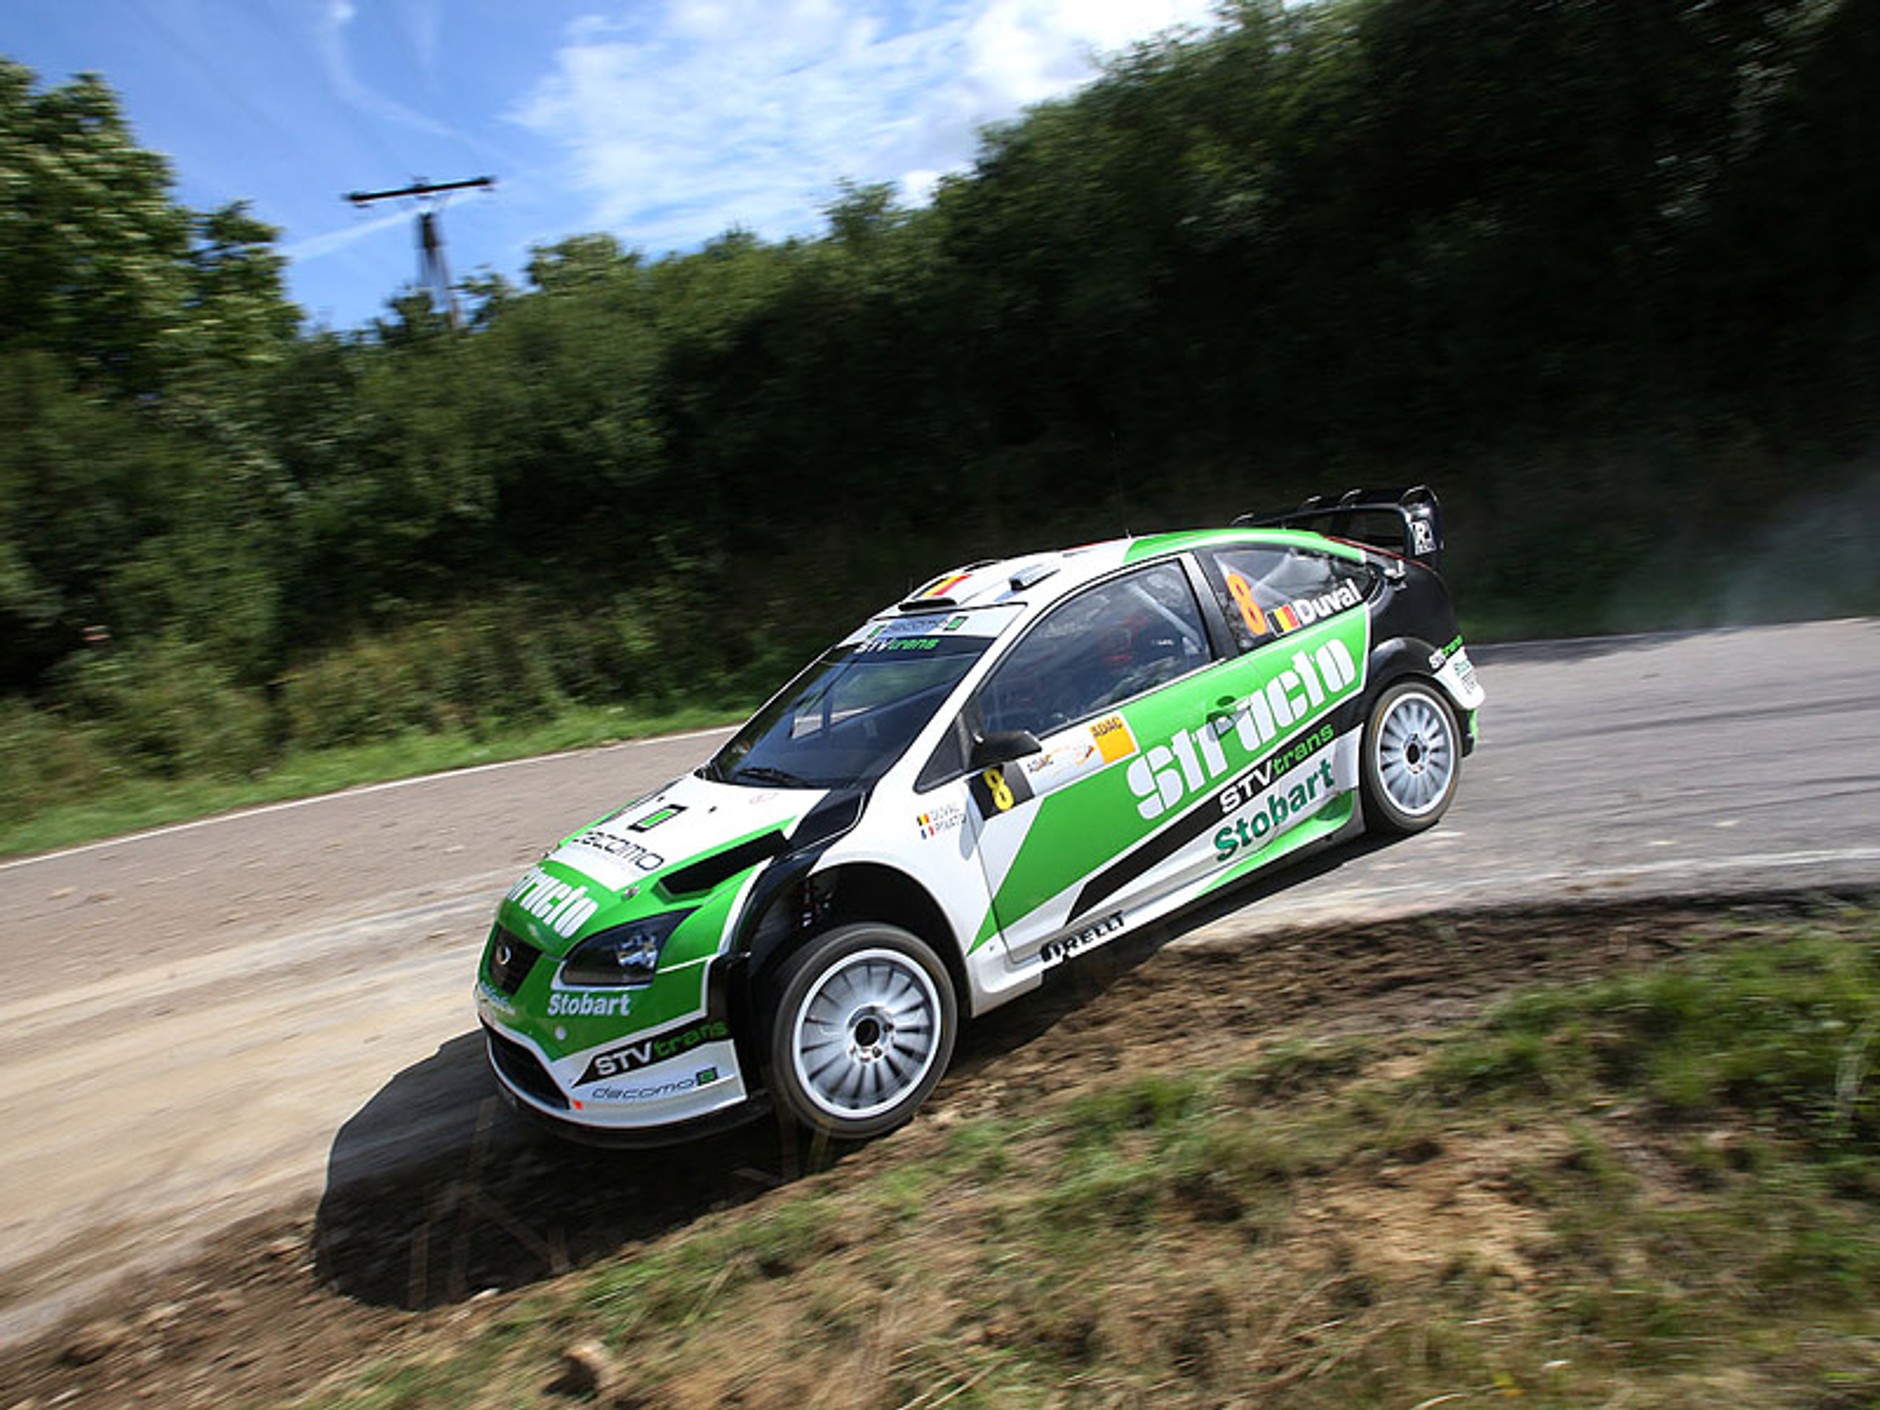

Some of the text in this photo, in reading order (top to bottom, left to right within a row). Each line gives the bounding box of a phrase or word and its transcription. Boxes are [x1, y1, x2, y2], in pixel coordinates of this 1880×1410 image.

[1227, 573, 1267, 636] 8
[1292, 578, 1363, 625] Duval
[1127, 638, 1357, 820] structo
[983, 768, 1014, 811] 8
[1213, 759, 1335, 862] Stobart
[547, 991, 631, 1016] Stobart
[592, 1078, 694, 1099] decomo
